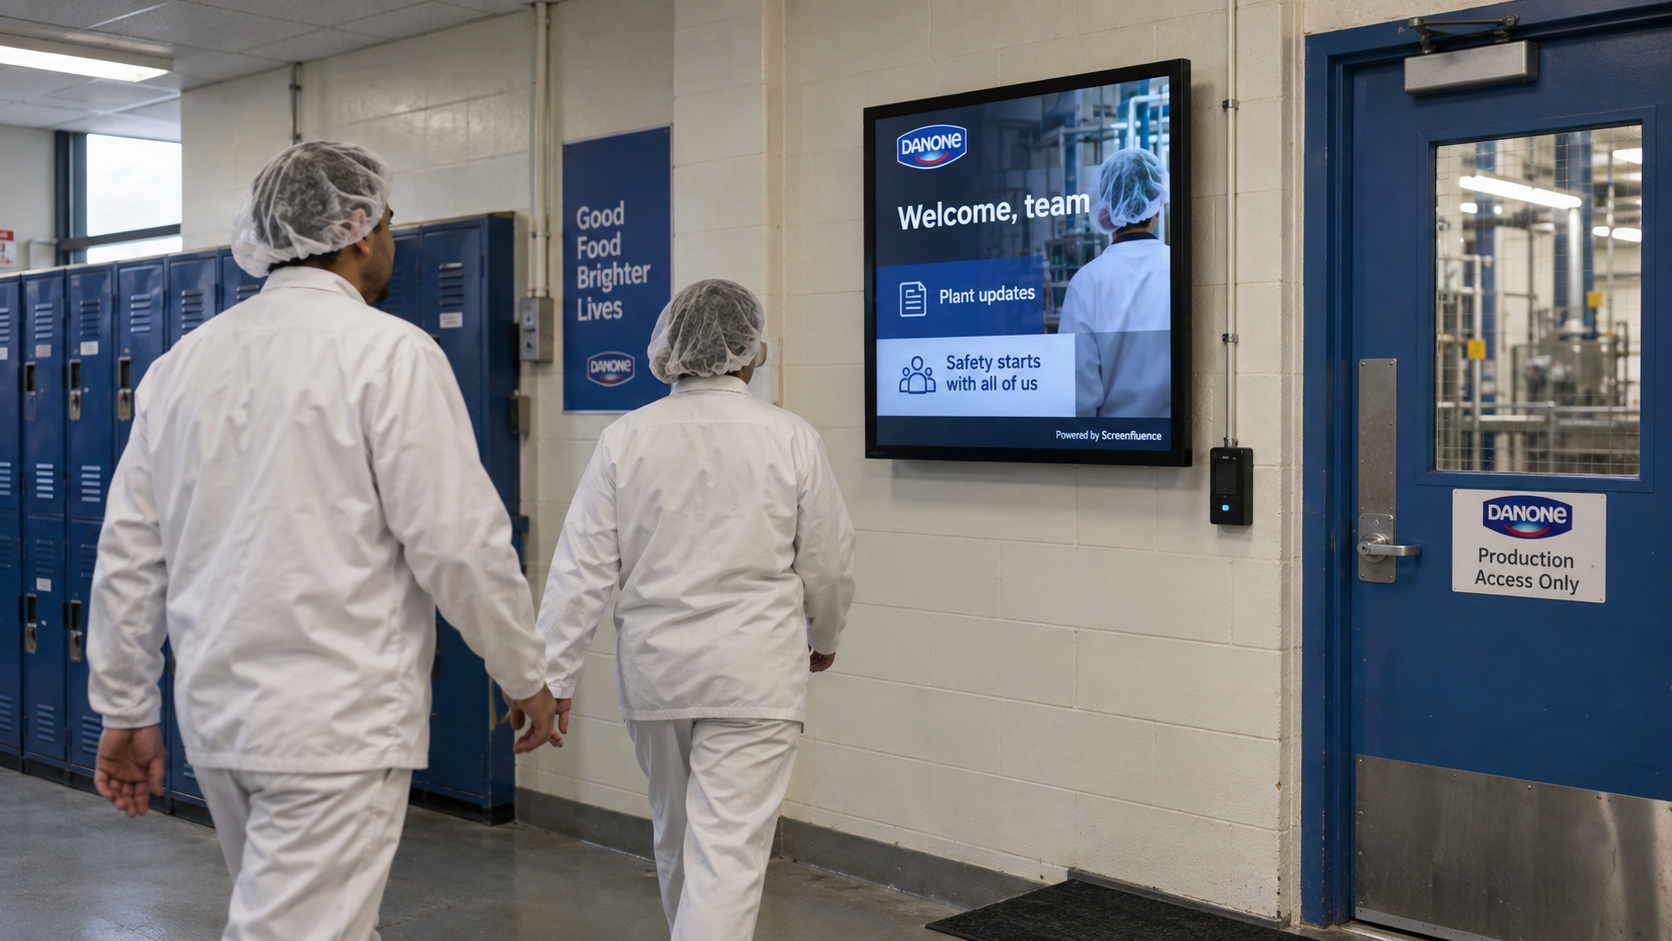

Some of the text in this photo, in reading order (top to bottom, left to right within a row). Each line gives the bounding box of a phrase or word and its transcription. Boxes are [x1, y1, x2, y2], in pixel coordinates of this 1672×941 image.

[576, 200, 624, 230] Good
[897, 192, 1090, 230] Welcome, team
[577, 231, 621, 260] Food
[577, 261, 651, 293] Brighter
[940, 285, 1036, 306] Plant updates
[577, 296, 623, 321] Lives
[946, 353, 1041, 373] Safety starts
[946, 374, 1038, 391] with all of us
[1055, 430, 1163, 442] Powered by Screenfluence
[1478, 547, 1574, 569] Production
[1474, 569, 1580, 596] Access Only
